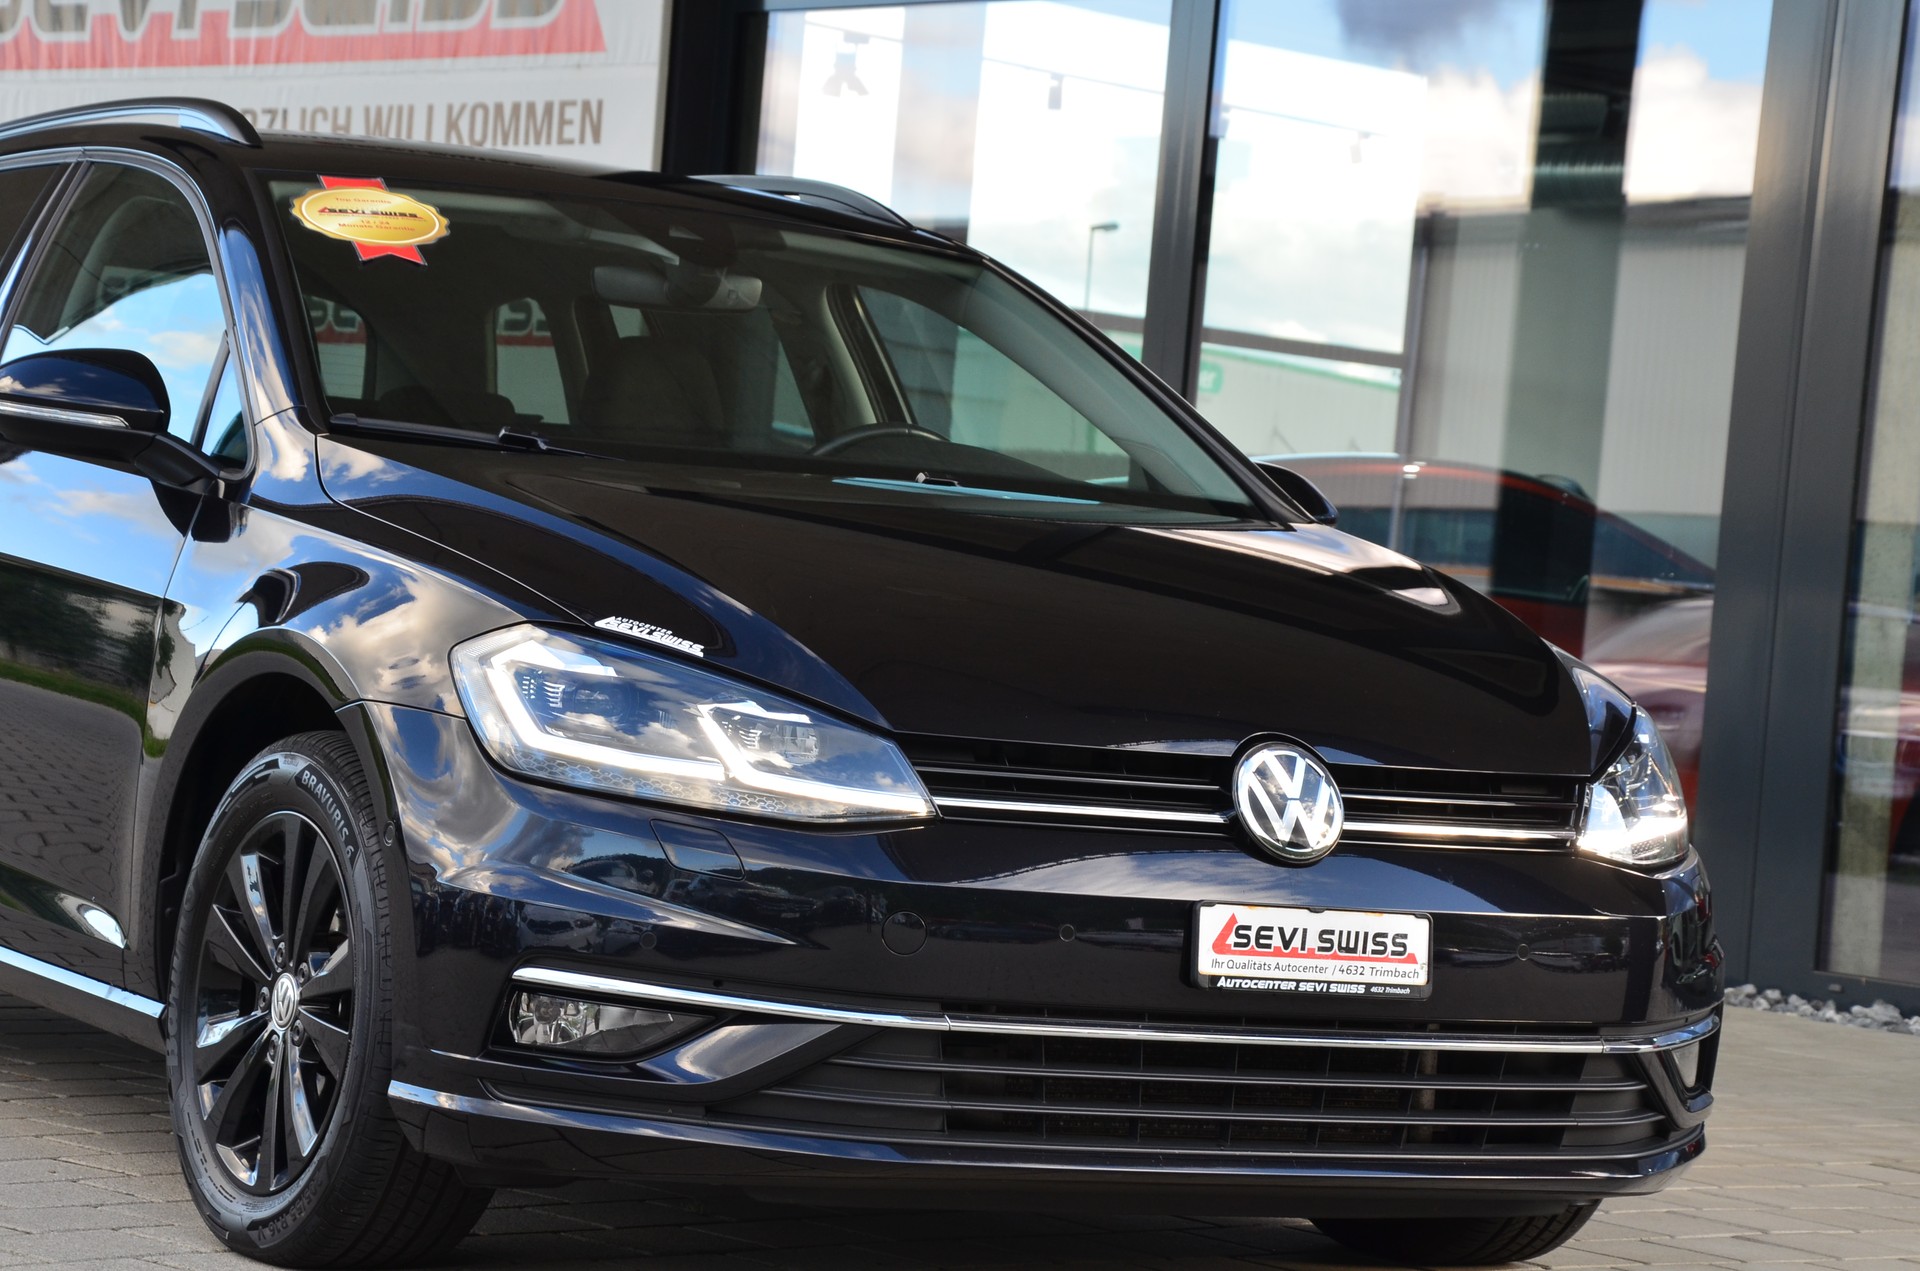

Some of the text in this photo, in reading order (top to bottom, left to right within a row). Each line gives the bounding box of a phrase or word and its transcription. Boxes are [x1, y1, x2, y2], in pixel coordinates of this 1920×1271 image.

[615, 617, 673, 635] AUTOCENTER
[301, 770, 355, 859] BRAVURIS 6
[1233, 924, 1409, 956] SEVI SWISS
[1211, 958, 1225, 969] Ihr
[1226, 959, 1272, 972] Qualitäts
[1273, 962, 1329, 974] Autocenter
[1338, 965, 1365, 976] 4632
[1369, 966, 1420, 979] Trimbach
[1298, 981, 1328, 993] SEVI
[1329, 983, 1366, 994] SWISS
